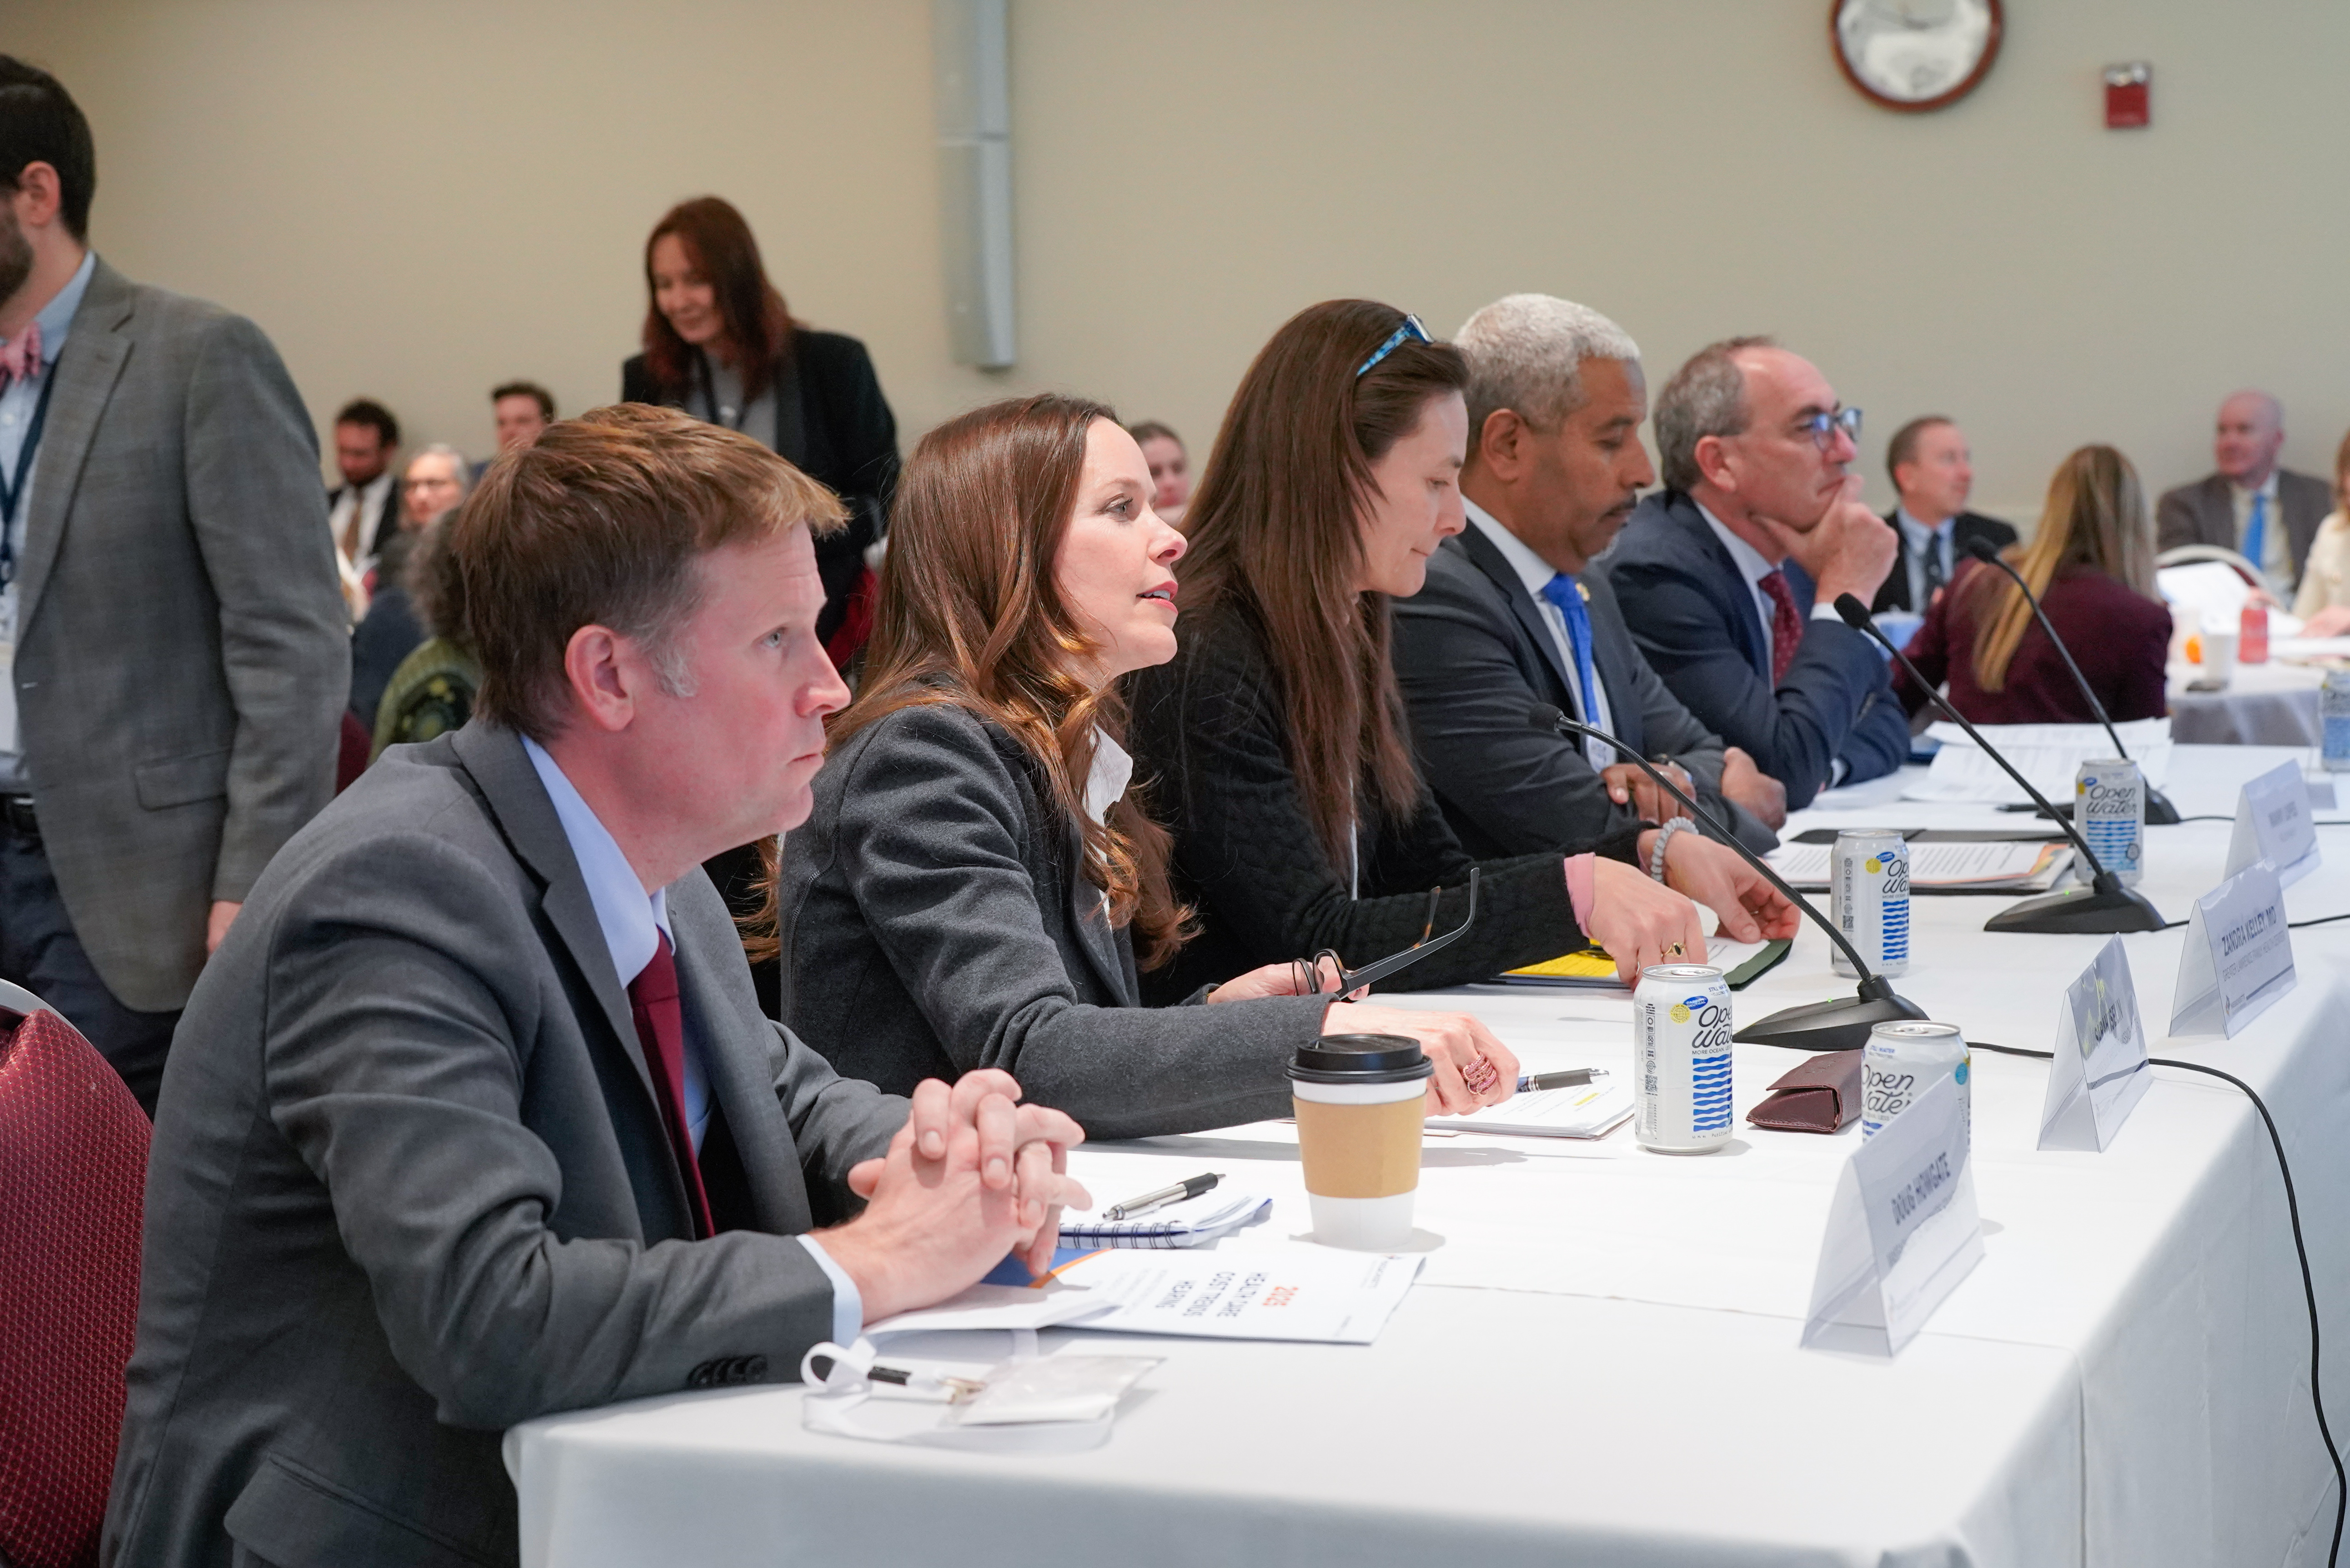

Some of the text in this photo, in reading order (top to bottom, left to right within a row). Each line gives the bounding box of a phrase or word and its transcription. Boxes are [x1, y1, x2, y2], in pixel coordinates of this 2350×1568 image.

[2091, 784, 2136, 800] Open
[2087, 800, 2137, 814] Water
[1888, 859, 1909, 878] Op
[2222, 906, 2277, 956] ZANDRA KELLEY, MD
[1699, 1005, 1732, 1029] Ope
[1891, 1183, 1916, 1226] DOUG
[1913, 1151, 1951, 1205] HOWGATE
[1154, 1279, 1198, 1309] HEARING
[1230, 1271, 1270, 1300] HEALTH
